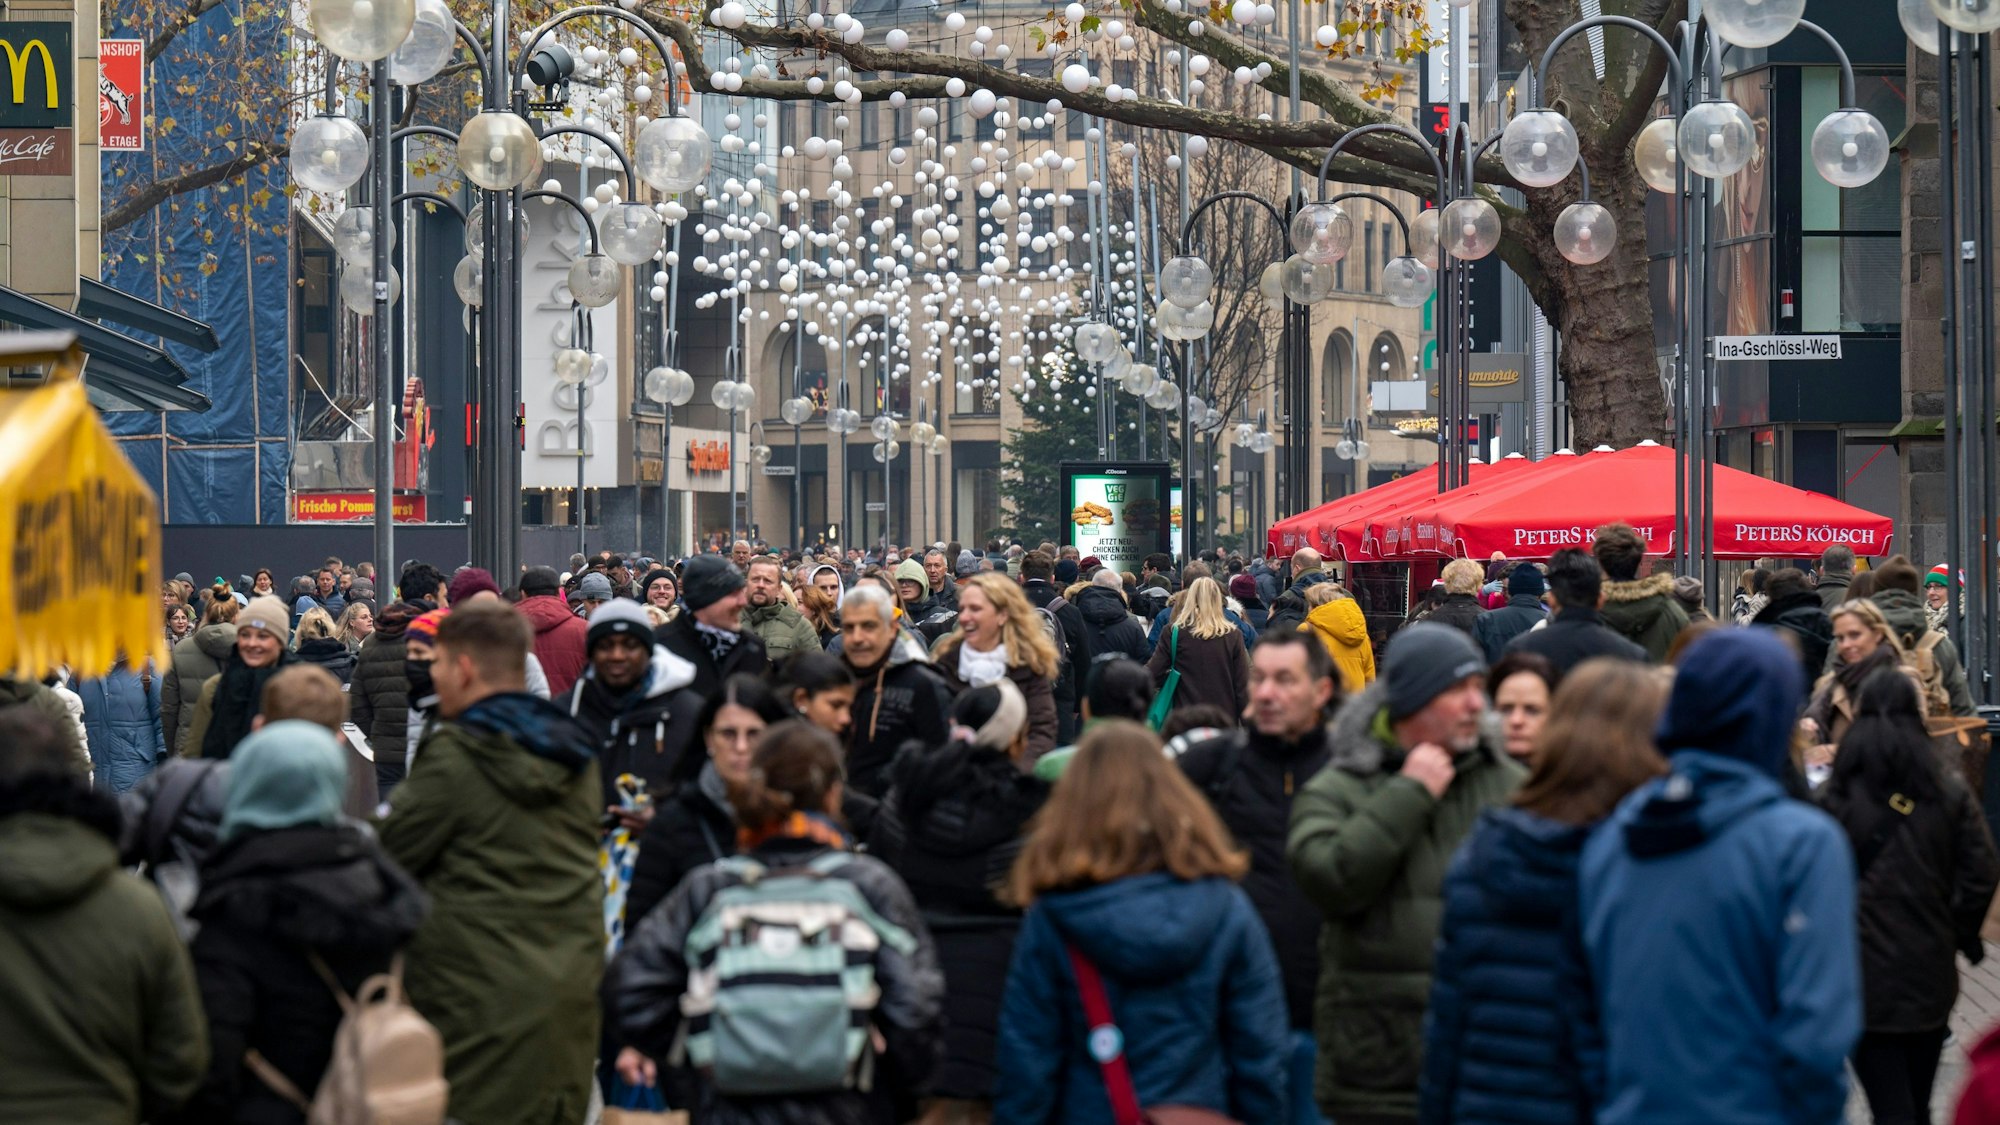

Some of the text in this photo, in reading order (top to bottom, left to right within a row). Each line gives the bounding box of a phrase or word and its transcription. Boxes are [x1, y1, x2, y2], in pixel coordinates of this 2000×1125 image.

[109, 136, 138, 147] ETAGE
[536, 203, 595, 457] Bechka
[1719, 339, 1838, 358] Ina-Gschlössl-Weg
[1106, 485, 1124, 493] VEG
[300, 498, 337, 513] Frische
[340, 500, 376, 513] Pomm
[392, 505, 413, 516] urst
[1806, 525, 1875, 544] KÖLSCH
